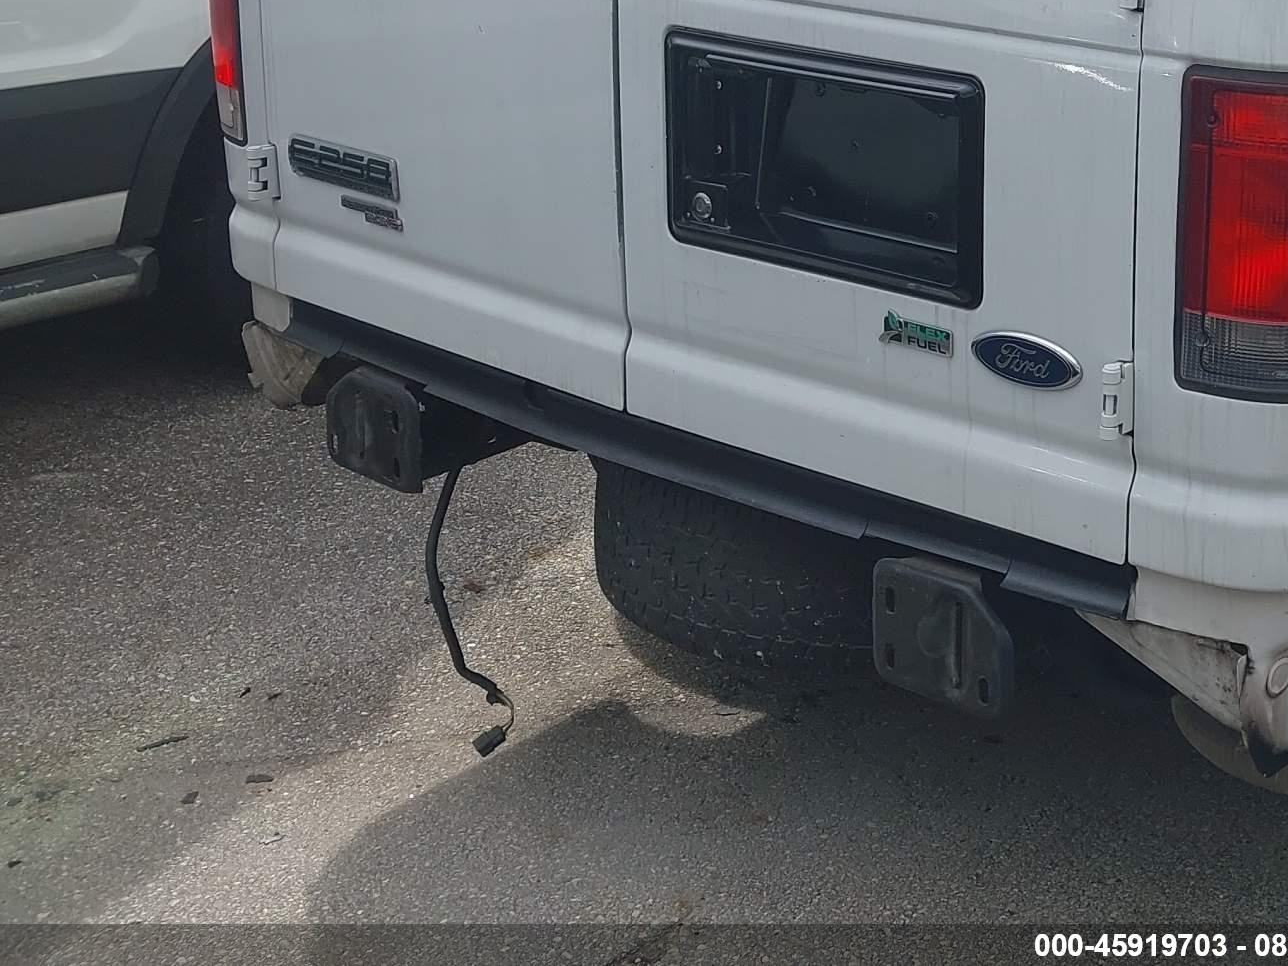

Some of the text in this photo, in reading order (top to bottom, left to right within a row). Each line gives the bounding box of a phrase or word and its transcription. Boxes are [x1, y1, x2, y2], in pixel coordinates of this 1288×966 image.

[906, 321, 949, 342] FLEX
[907, 336, 947, 355] FUEL
[994, 342, 1050, 379] Ford
